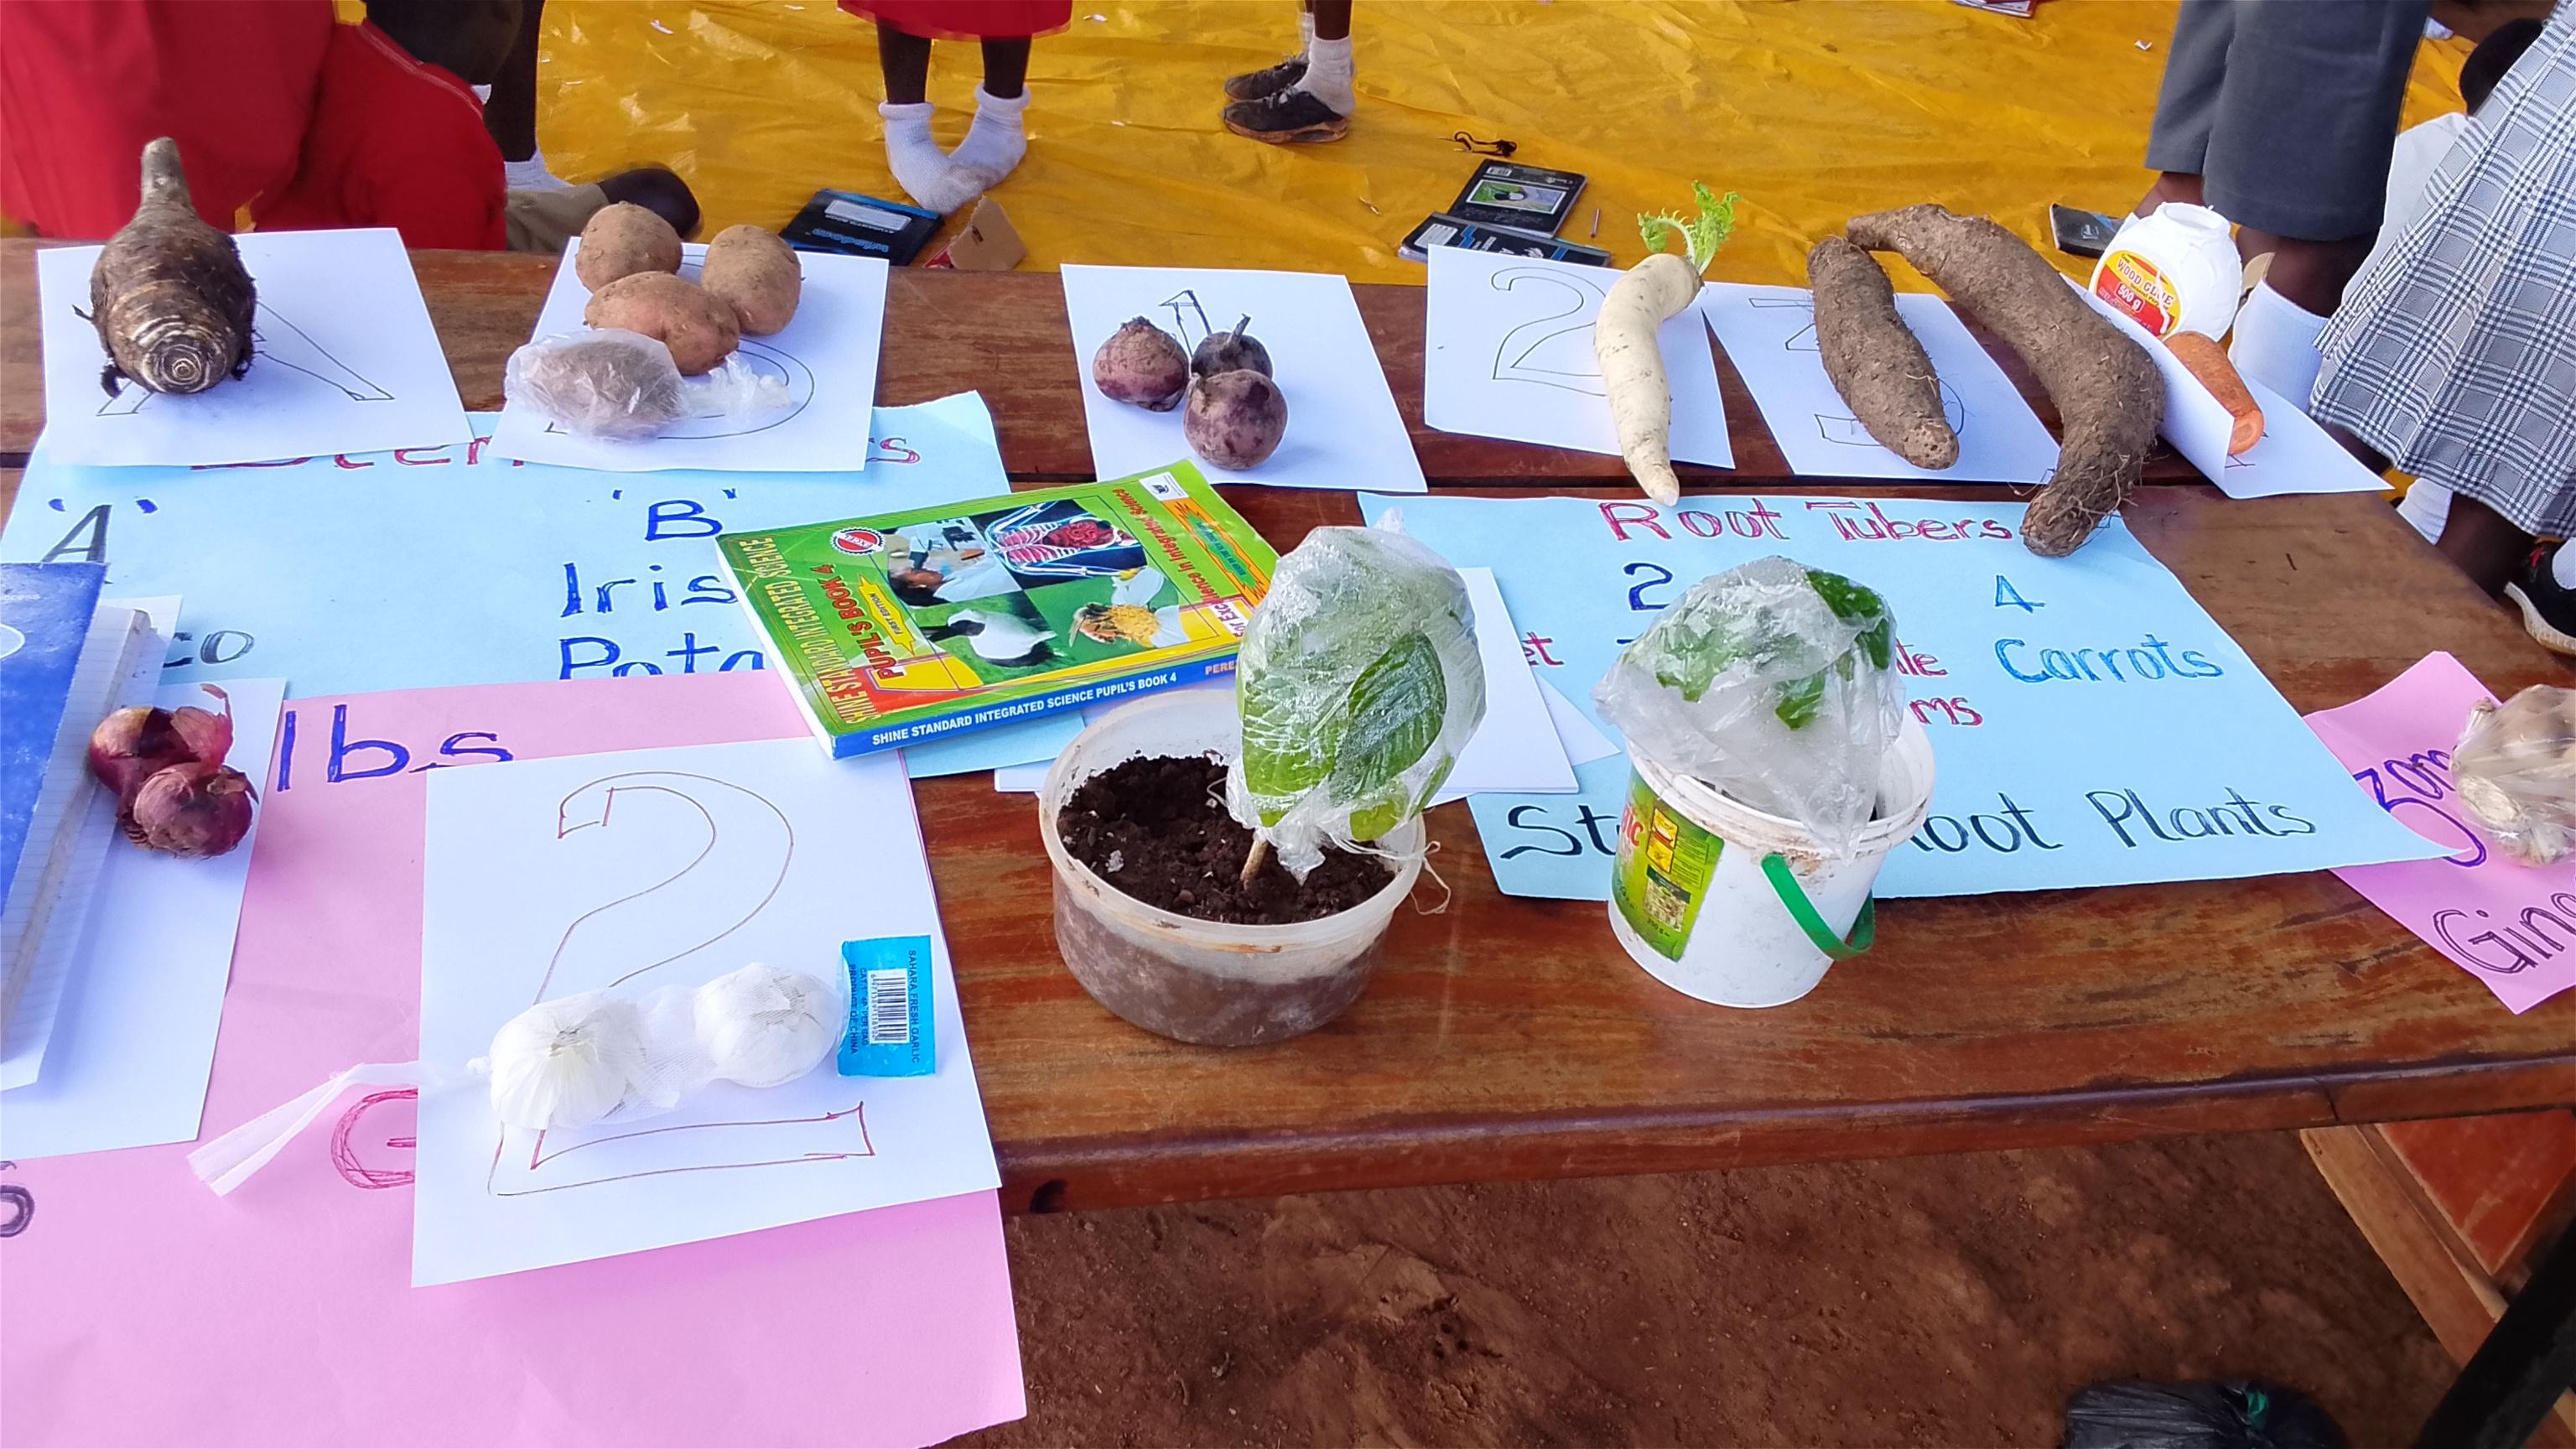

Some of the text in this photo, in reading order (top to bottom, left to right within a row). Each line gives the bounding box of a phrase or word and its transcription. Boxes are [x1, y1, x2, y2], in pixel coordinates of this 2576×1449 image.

[2117, 258, 2143, 286] WOOD
[2116, 284, 2143, 311] 500 g
[1111, 487, 1149, 518] Science
[1598, 497, 2014, 542] Root Tubers
[739, 537, 793, 579] SCIENCE
[560, 562, 739, 618] Iris
[764, 580, 832, 640] INTEGRATED
[1623, 562, 1674, 611] 2
[1994, 574, 2045, 614] 4
[810, 563, 905, 680] PUPIL'S BOOK 4
[800, 639, 864, 693] STANDARD
[1204, 662, 1237, 676] PERE
[1994, 633, 2225, 684] Carrots
[872, 672, 1177, 746] SHINE STANDARD INTEGRATED SCIENCE PUPIL'S BOOK 4
[1912, 792, 2064, 853] oot
[2085, 787, 2317, 849] Plants
[908, 949, 922, 1064] SAHARA FRESH GARLIC
[850, 1026, 860, 1055] CHINA
